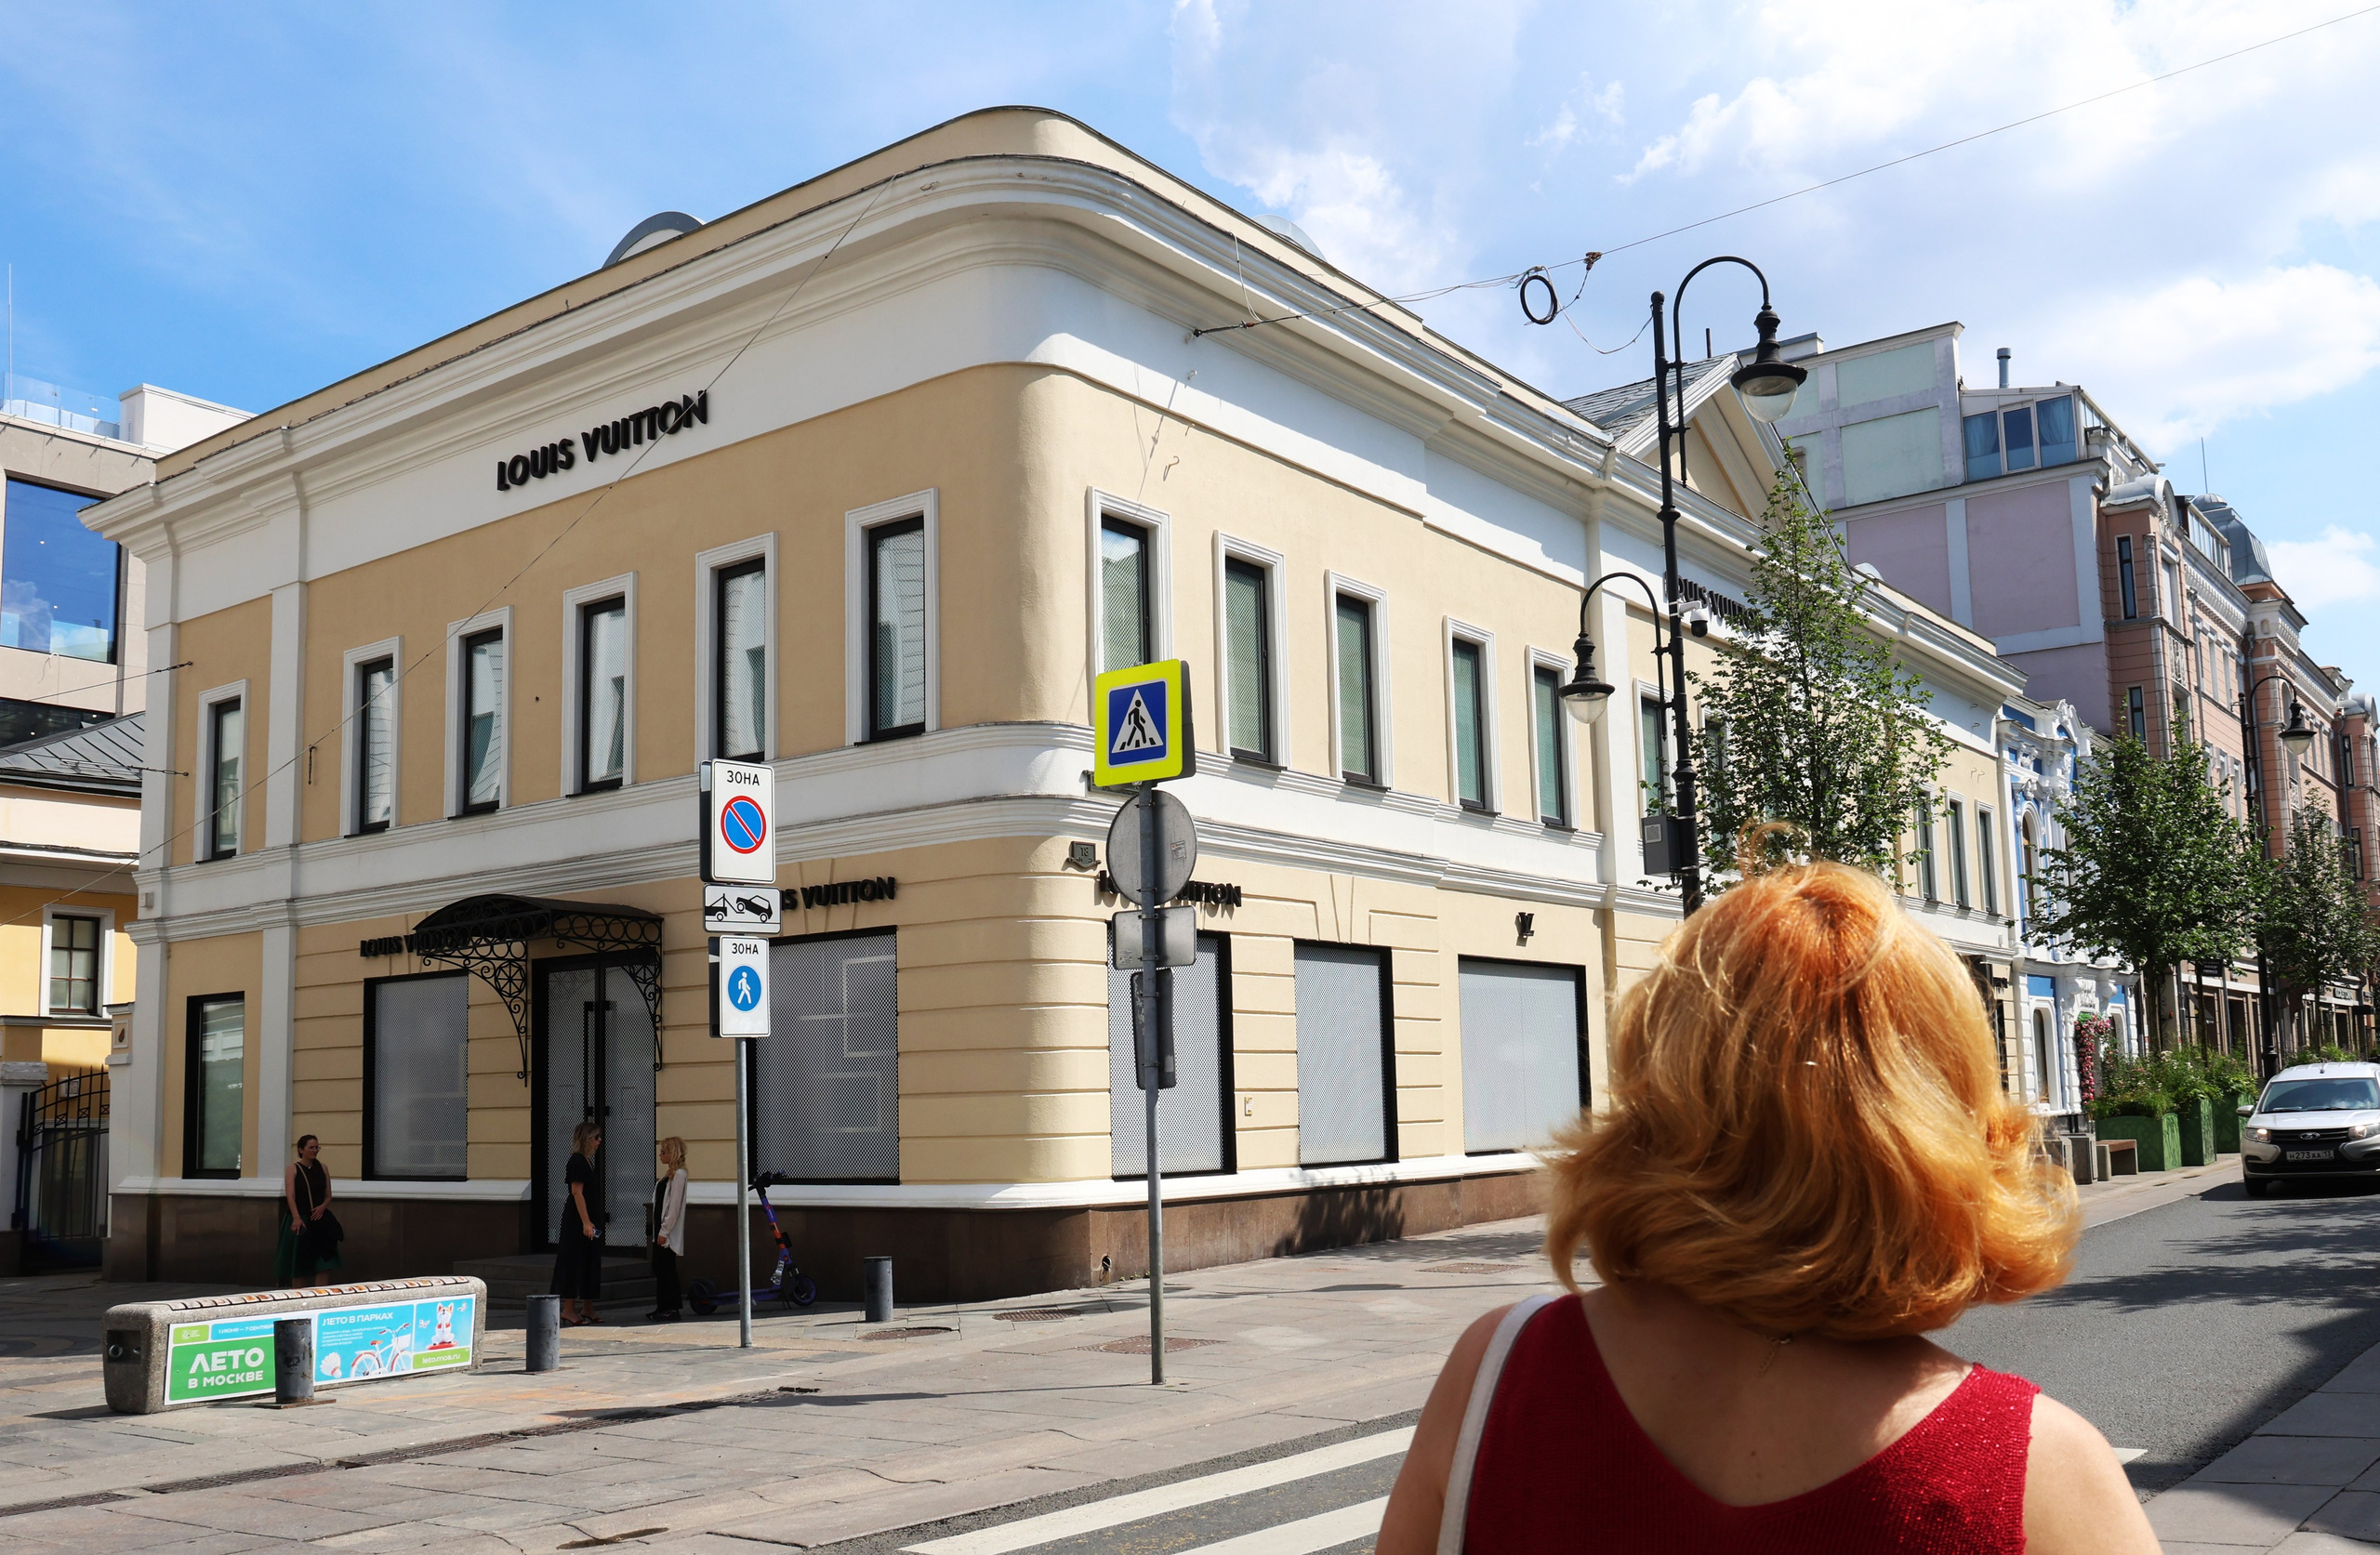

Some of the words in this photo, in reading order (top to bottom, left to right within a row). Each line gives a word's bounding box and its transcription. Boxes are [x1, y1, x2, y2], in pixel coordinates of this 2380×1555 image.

[497, 439, 574, 491] LOUIS
[581, 389, 707, 462] VUITTON
[726, 770, 760, 786] ЗОНА
[800, 876, 894, 909] VUITTON
[1175, 880, 1241, 907] UITTON
[731, 942, 759, 955] ЗОНА
[322, 1316, 348, 1326] ЛЕТО
[349, 1314, 356, 1324] В
[357, 1311, 393, 1323] ПАРКАХ
[189, 1347, 265, 1375] ЛЕТО
[422, 1353, 461, 1364] leto.mos.ru
[188, 1377, 198, 1390] В
[203, 1370, 263, 1388] МОСКВЕ
